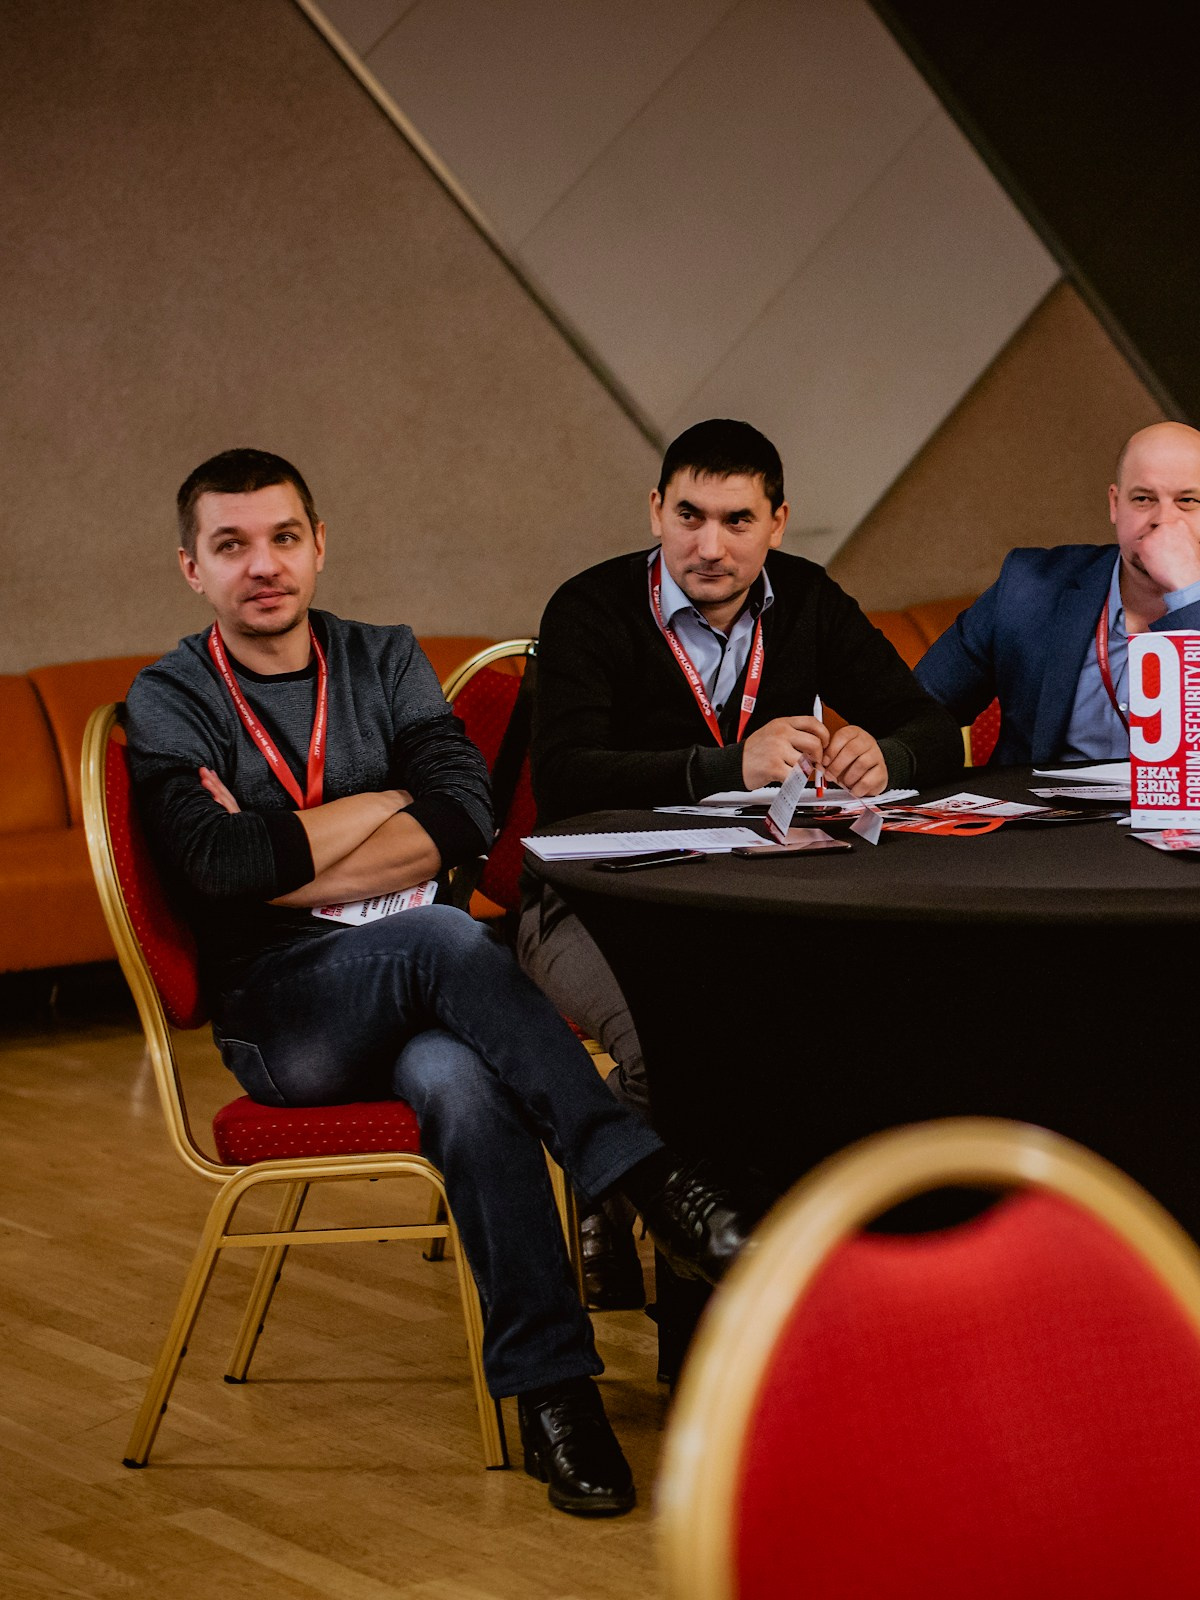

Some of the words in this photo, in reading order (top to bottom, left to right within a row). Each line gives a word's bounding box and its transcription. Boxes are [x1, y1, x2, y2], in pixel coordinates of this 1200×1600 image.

[695, 686, 711, 717] ФОРУМ
[1128, 635, 1181, 762] 9
[1137, 767, 1180, 779] EKAT
[1137, 780, 1180, 793] ERIN
[1137, 793, 1181, 806] BURG
